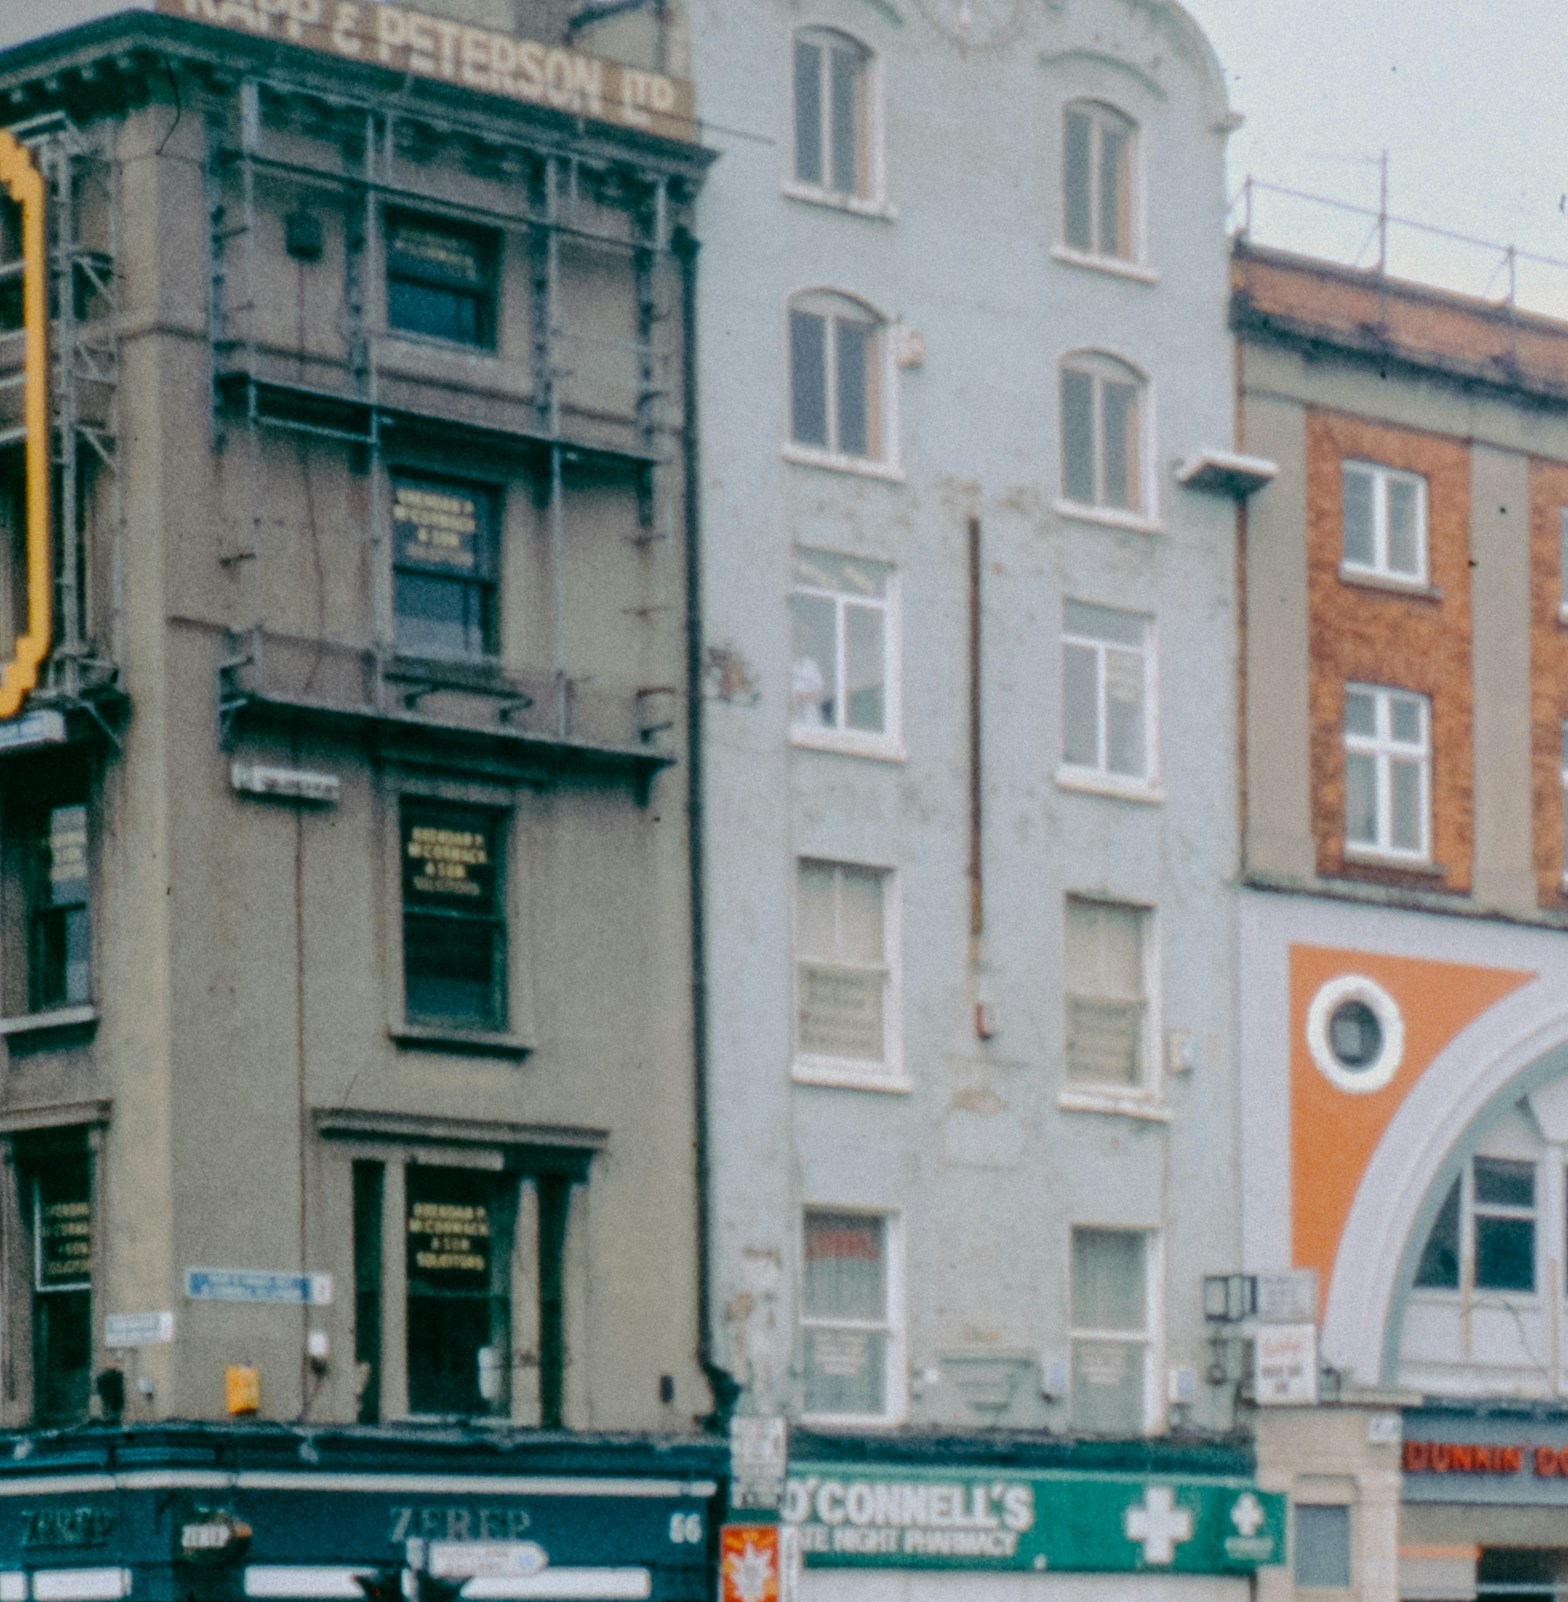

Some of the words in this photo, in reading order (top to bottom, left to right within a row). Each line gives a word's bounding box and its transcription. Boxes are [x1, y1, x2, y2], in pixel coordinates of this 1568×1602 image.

[184, 0, 321, 40] APP
[333, 2, 362, 53] &
[380, 4, 602, 117] PETERSON
[622, 70, 676, 124] LTD
[389, 1507, 531, 1542] ZEREP
[780, 1476, 1035, 1531] O'CONNELL'S
[833, 1526, 899, 1552] NIGHT
[903, 1529, 1020, 1556] PHARMACY
